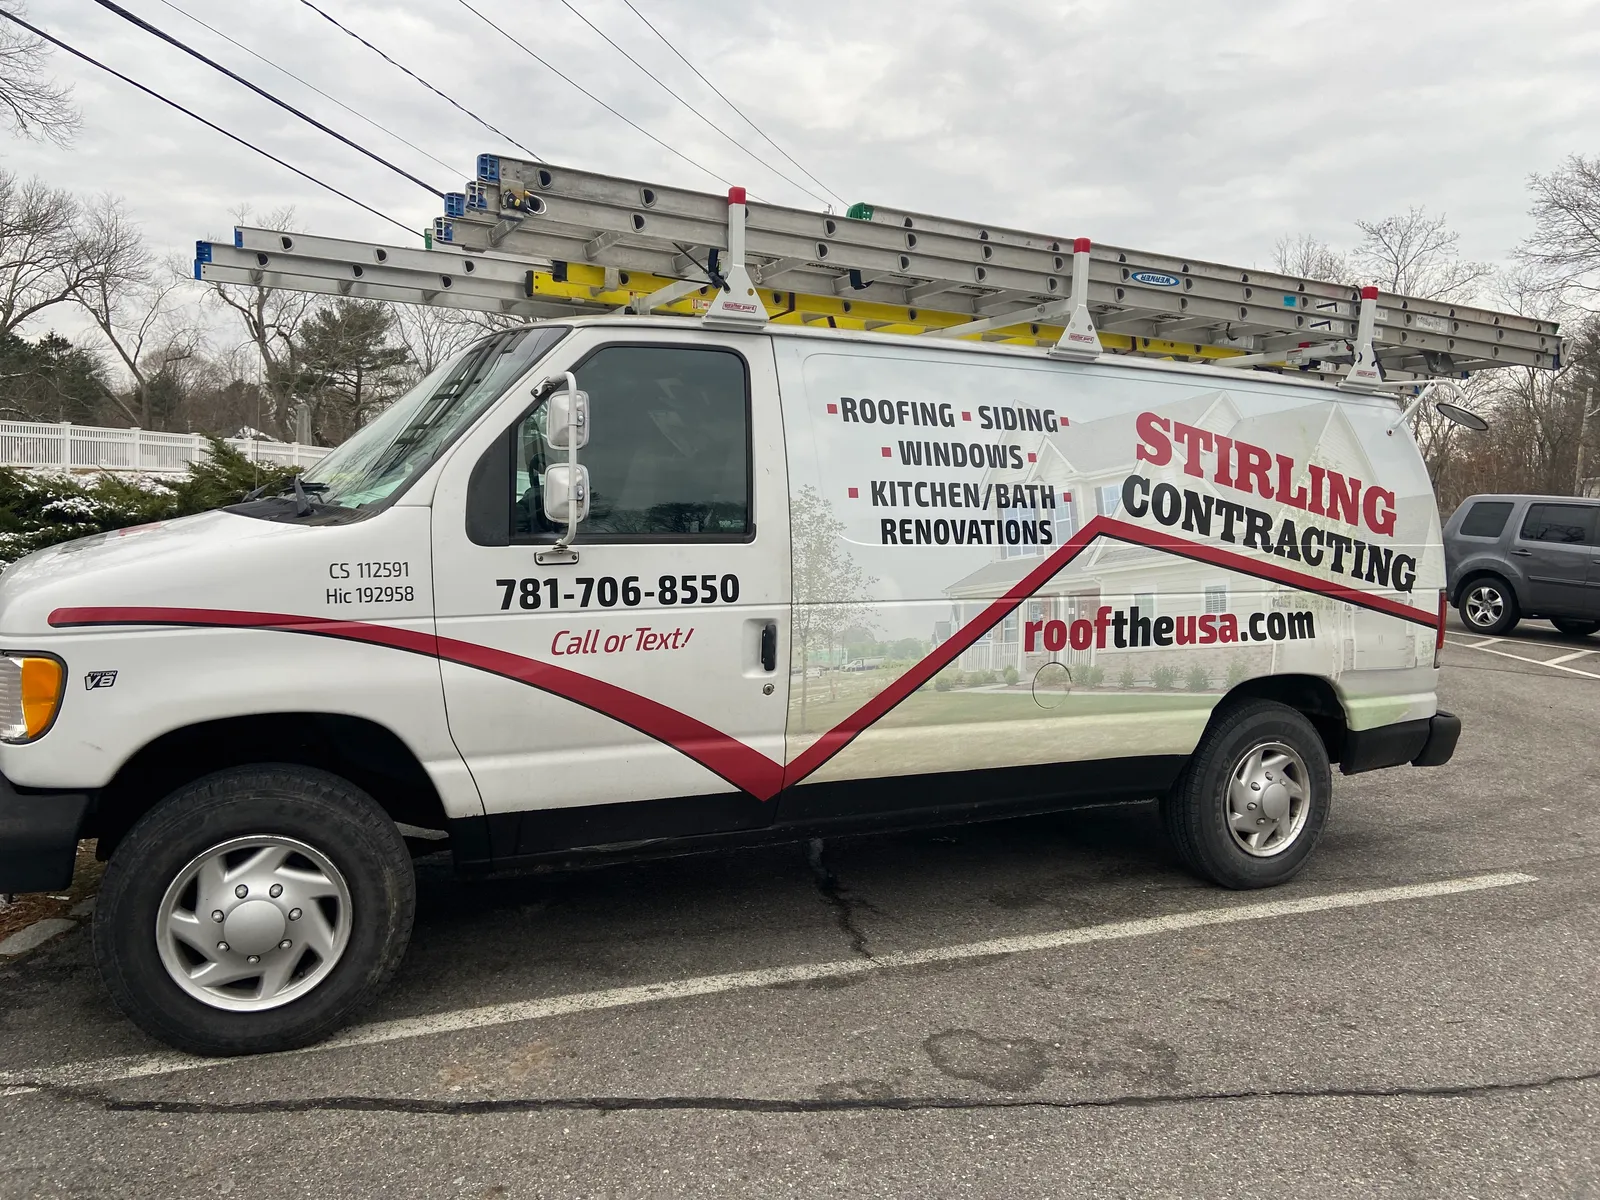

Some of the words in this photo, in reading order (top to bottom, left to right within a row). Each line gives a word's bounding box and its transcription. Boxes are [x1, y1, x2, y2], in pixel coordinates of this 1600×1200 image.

[1140, 275, 1172, 284] WERNER
[842, 397, 954, 427] ROOFING
[979, 405, 1058, 433] SIDING
[898, 441, 1023, 469] WINDOWS
[1136, 412, 1397, 537] STIRLING
[871, 481, 1056, 510] KITCHEN/BATH
[881, 518, 1052, 545] RENOVATIONS
[1122, 475, 1415, 593] CONTRACTING
[329, 563, 350, 579] CS
[358, 561, 409, 578] 112591
[326, 588, 352, 604] Hic
[356, 586, 414, 603] 192958
[496, 574, 739, 610] 781-706-8550
[551, 629, 597, 656] Call
[604, 634, 632, 653] or
[634, 627, 694, 651] Text!
[1025, 606, 1316, 652] rooftheusa.com
[85, 676, 114, 690] V8
